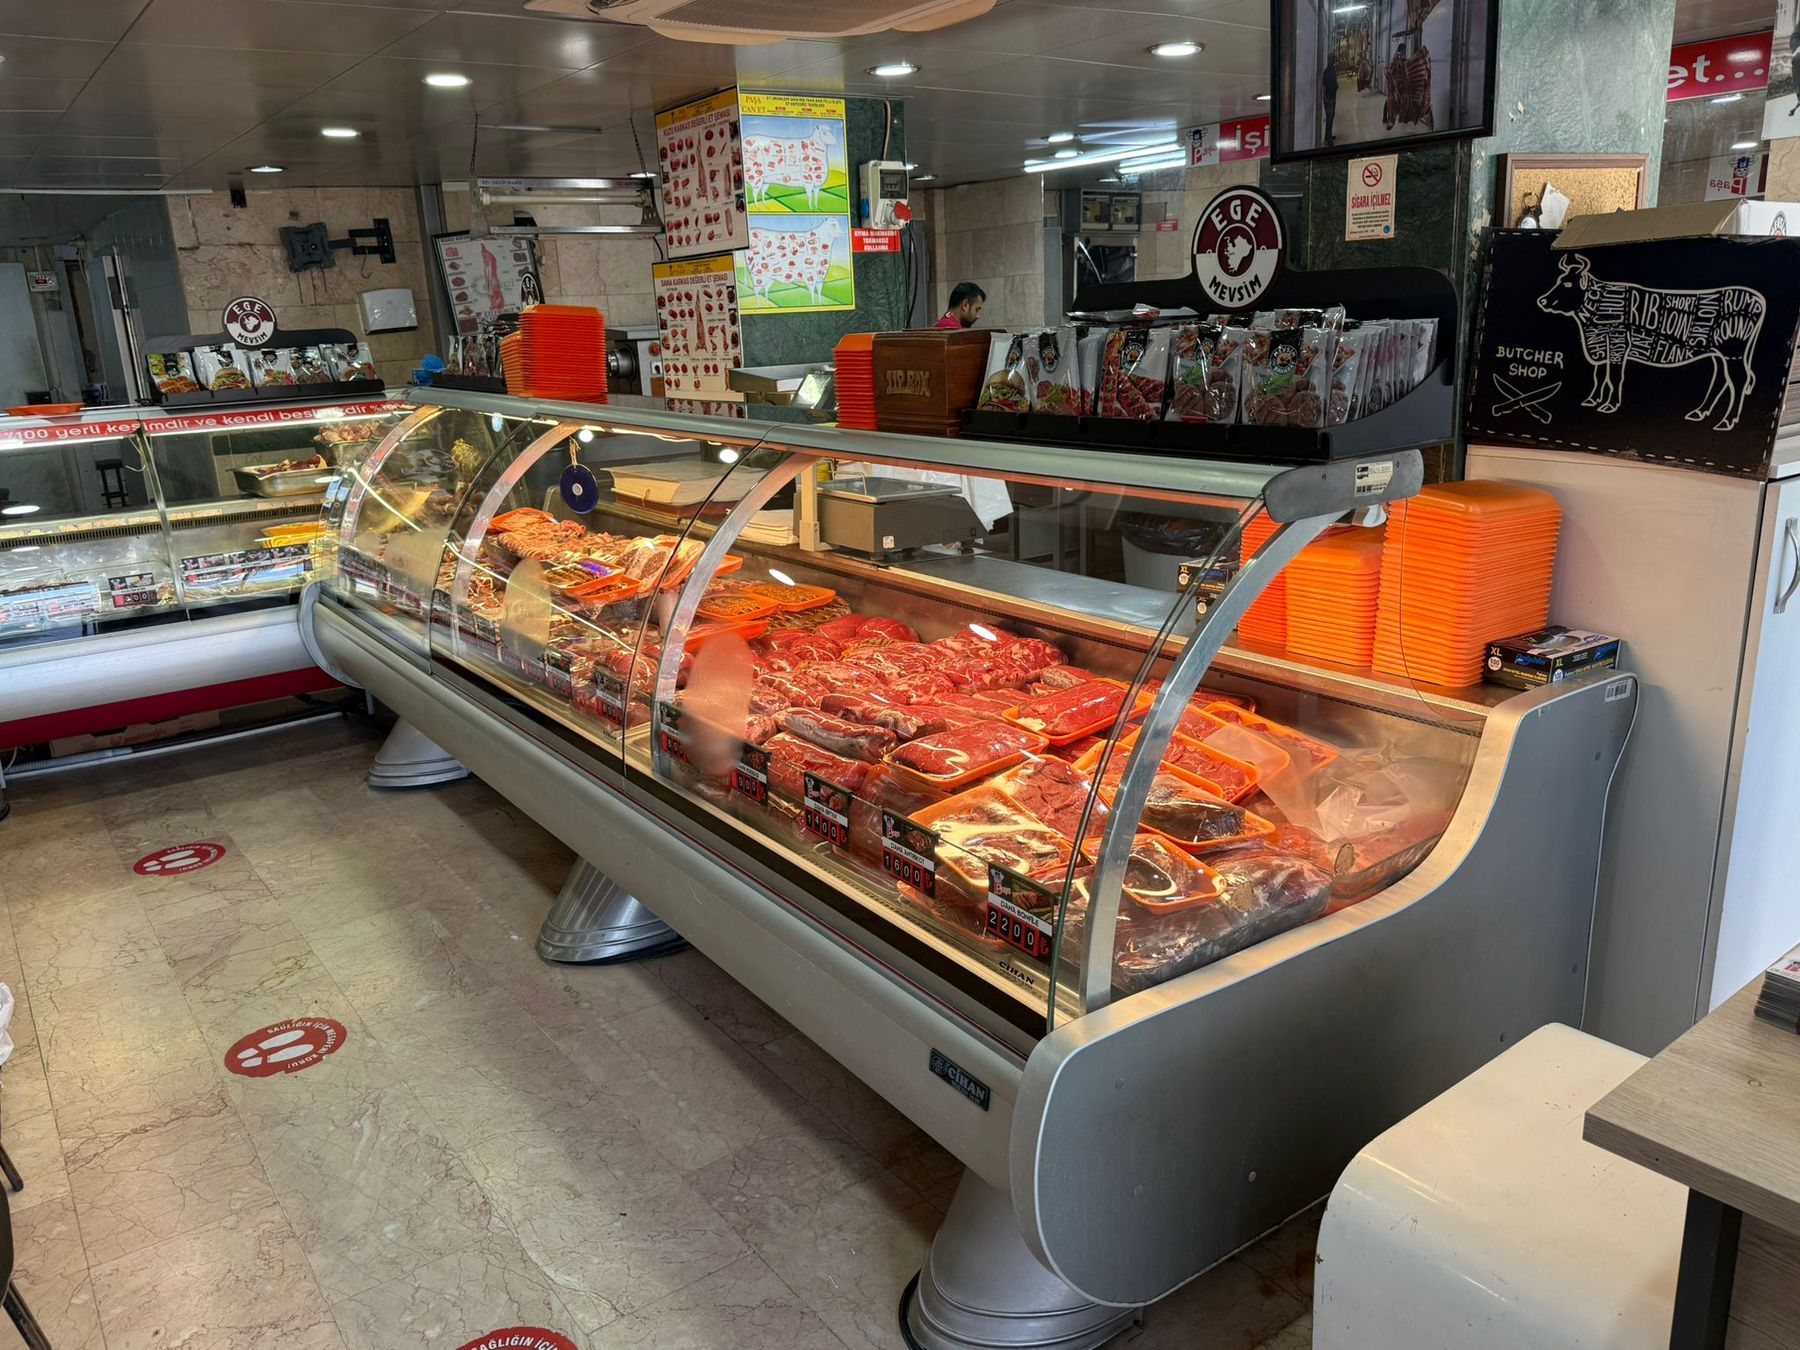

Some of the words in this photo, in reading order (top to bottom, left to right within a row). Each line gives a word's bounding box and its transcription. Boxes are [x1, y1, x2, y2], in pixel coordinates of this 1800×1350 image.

[1351, 194, 1370, 209] SİGARA
[1370, 191, 1391, 210] İÇİLMEZ
[1210, 199, 1262, 231] EGE
[1209, 274, 1262, 303] MEVSİM
[1578, 280, 1602, 324] NECK
[1725, 289, 1762, 314] RUMP
[232, 301, 263, 315] EGE
[1593, 284, 1627, 324] CHUCK
[1630, 290, 1660, 330] RIB
[1666, 295, 1697, 312] SHORT
[1660, 310, 1693, 342] LOIN
[1688, 293, 1721, 347] SIRLOIN
[1714, 315, 1755, 346] ROUND
[237, 331, 268, 345] MEVSİM
[1609, 325, 1627, 362] BRISKET
[1495, 345, 1564, 370] BUTCHER
[1653, 340, 1694, 364] FLANK
[906, 369, 931, 397] BOX
[1508, 362, 1547, 380] SHOP
[56, 424, 100, 439] yerli
[195, 416, 217, 428] ve
[222, 411, 274, 427] kendi
[1490, 646, 1502, 657] XL
[807, 814, 836, 838] 1400
[885, 855, 920, 882] 1600
[1000, 900, 1017, 915] DANA
[990, 910, 1034, 946] 2200
